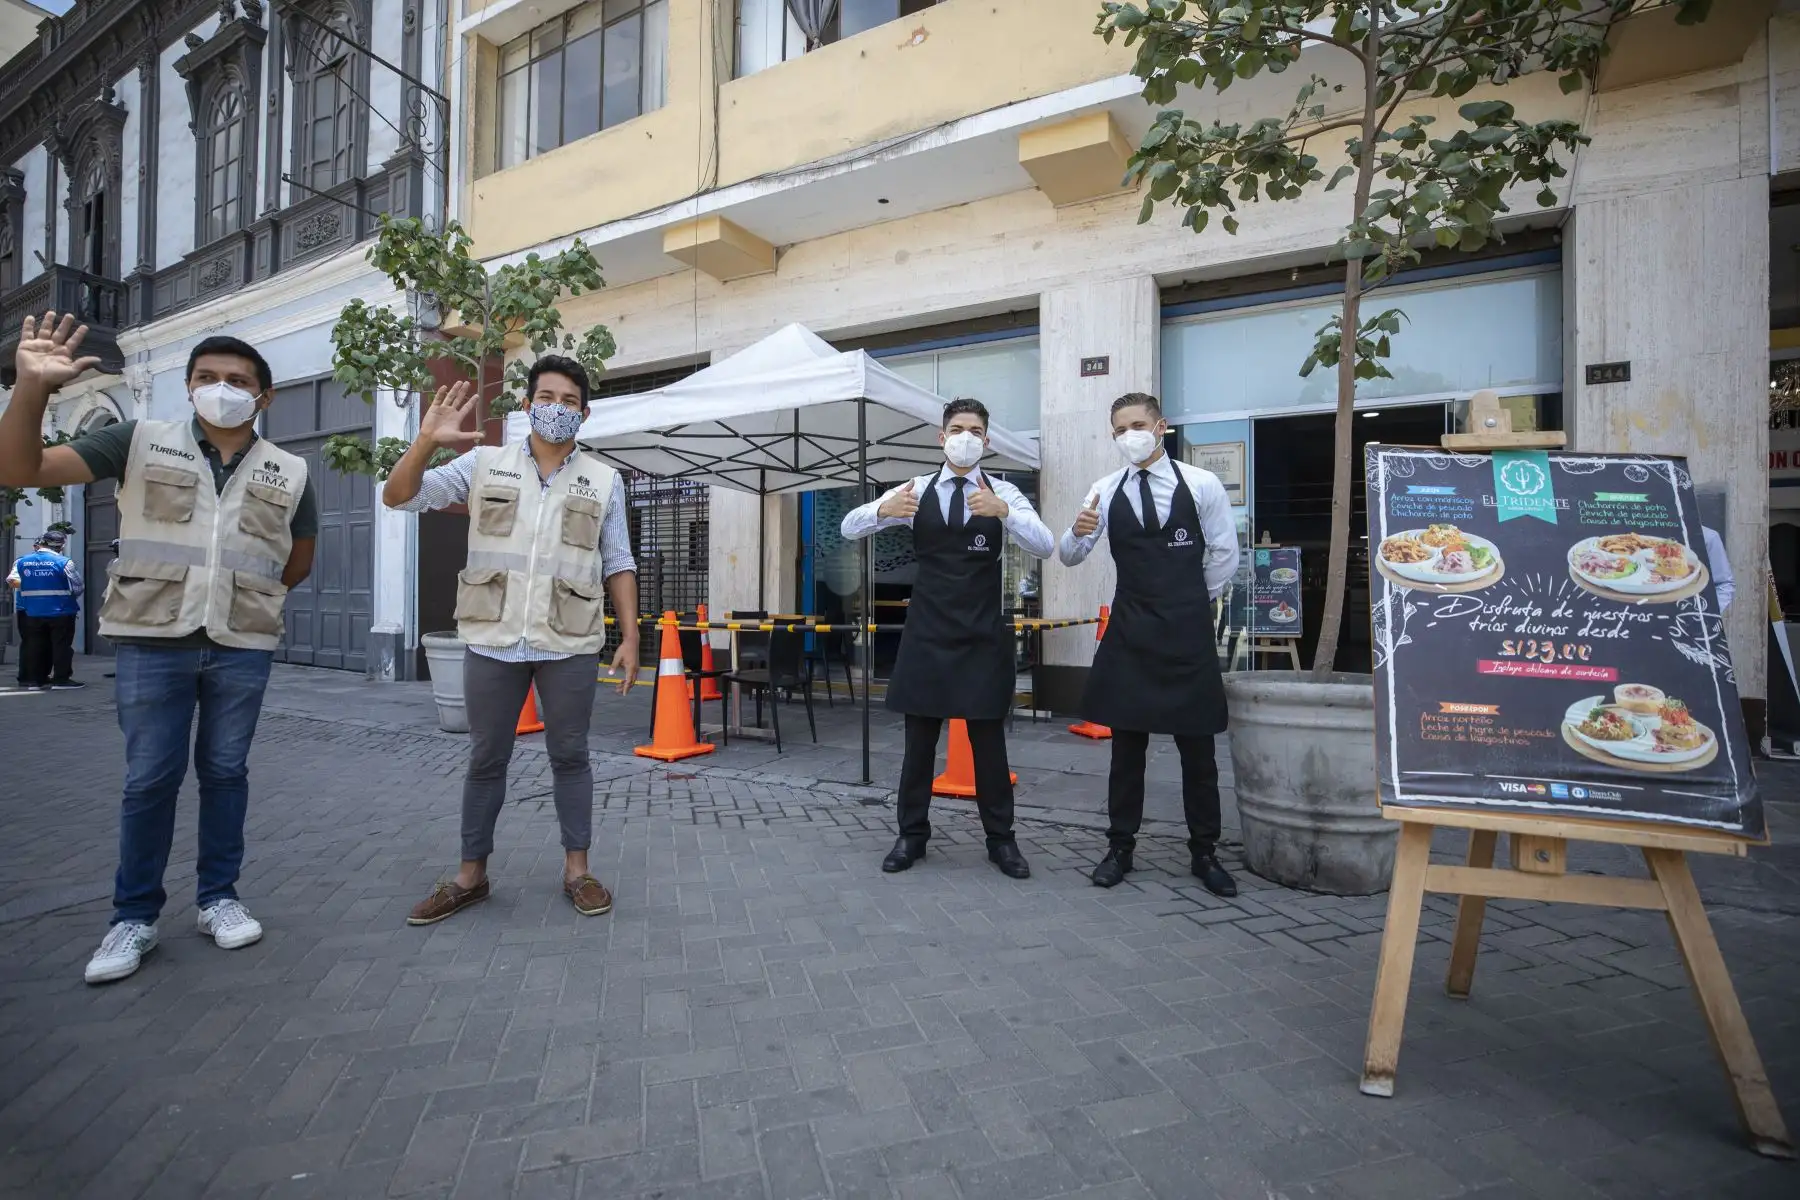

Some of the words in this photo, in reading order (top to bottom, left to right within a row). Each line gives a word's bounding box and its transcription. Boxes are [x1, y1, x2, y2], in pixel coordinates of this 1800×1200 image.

[1593, 367, 1624, 380] 344
[150, 443, 195, 461] TURISMO
[489, 469, 522, 480] TURISMO
[253, 473, 287, 490] LIMA
[568, 486, 597, 499] LIMA
[1391, 493, 1414, 502] Arroz
[1426, 503, 1435, 511] de
[1439, 504, 1473, 512] pescado
[1482, 494, 1497, 505] EL
[1499, 495, 1570, 508] TRIDENTE
[1453, 512, 1473, 520] pota
[1618, 510, 1628, 518] de
[1631, 511, 1668, 519] pescado
[1433, 594, 1543, 618] Disfruta
[1551, 600, 1573, 618] de
[1583, 605, 1653, 622] nuestros
[1514, 616, 1569, 637] divinos
[1577, 620, 1630, 639] desde
[1484, 661, 1522, 675] Incluye
[1561, 666, 1572, 675] de
[1420, 712, 1448, 722] Arroz
[1453, 724, 1465, 732] de
[1498, 727, 1509, 736] de
[1513, 729, 1556, 738] pescado
[1455, 733, 1466, 741] de
[1499, 782, 1528, 793] VISA
